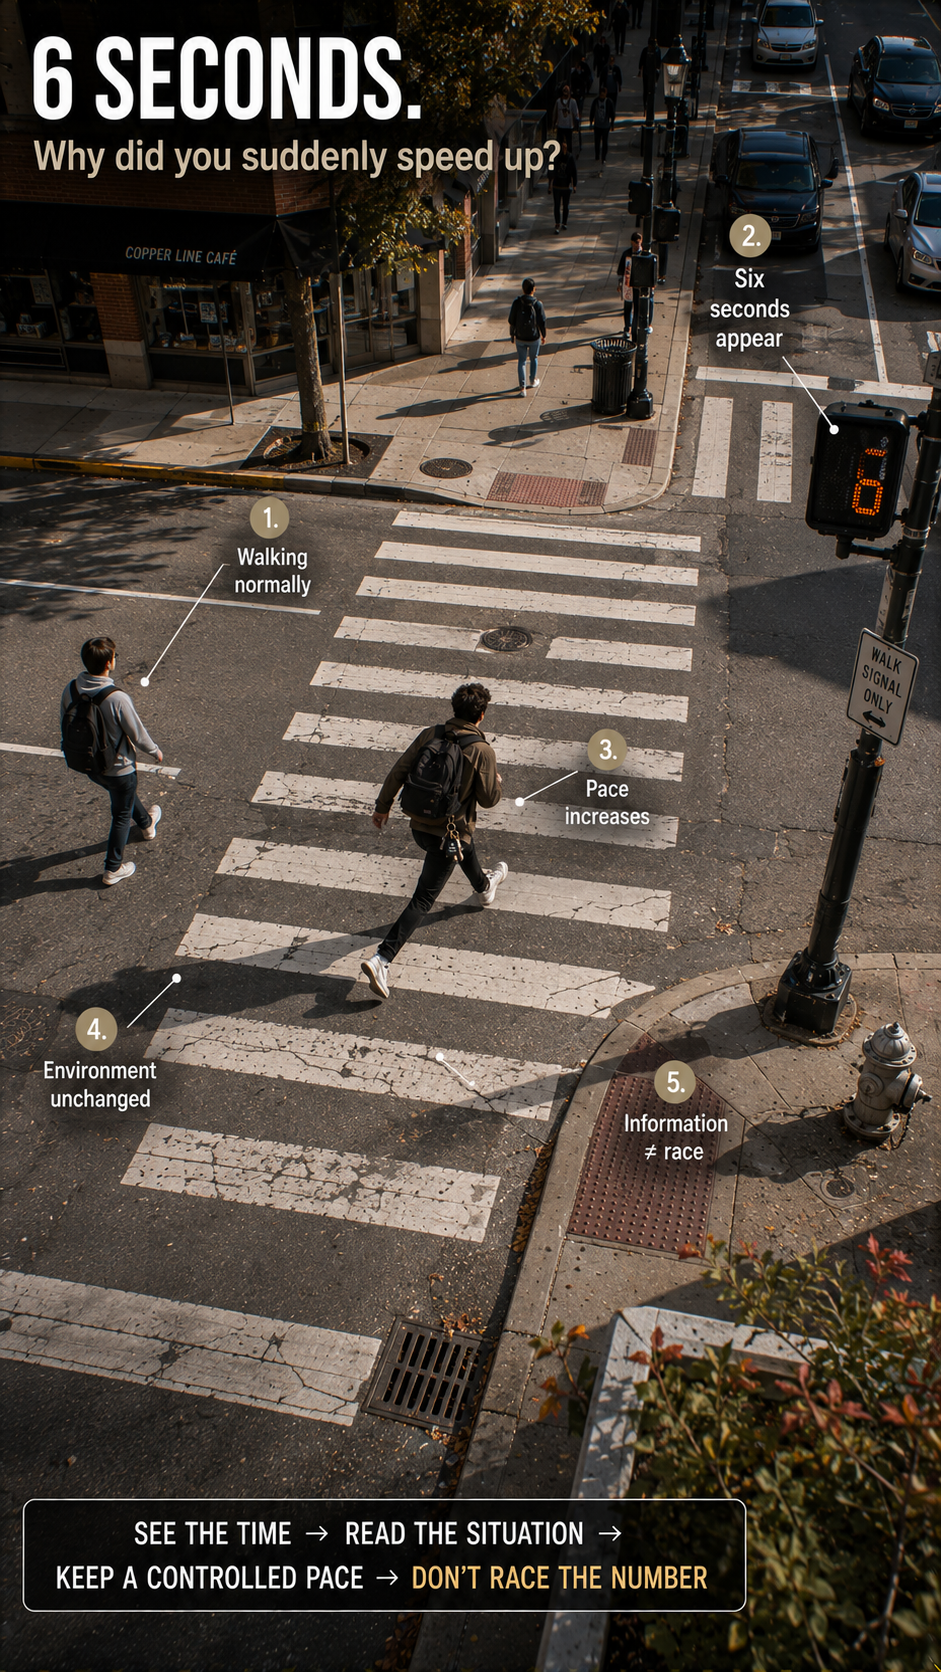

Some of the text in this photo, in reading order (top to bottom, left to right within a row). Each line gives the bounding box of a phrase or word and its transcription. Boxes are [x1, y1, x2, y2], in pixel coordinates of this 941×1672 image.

[126, 246, 237, 265] COPPER LINE CAFÉ
[871, 646, 902, 675] WALK
[862, 664, 902, 698] SIGNAL
[863, 688, 893, 714] ONLY
